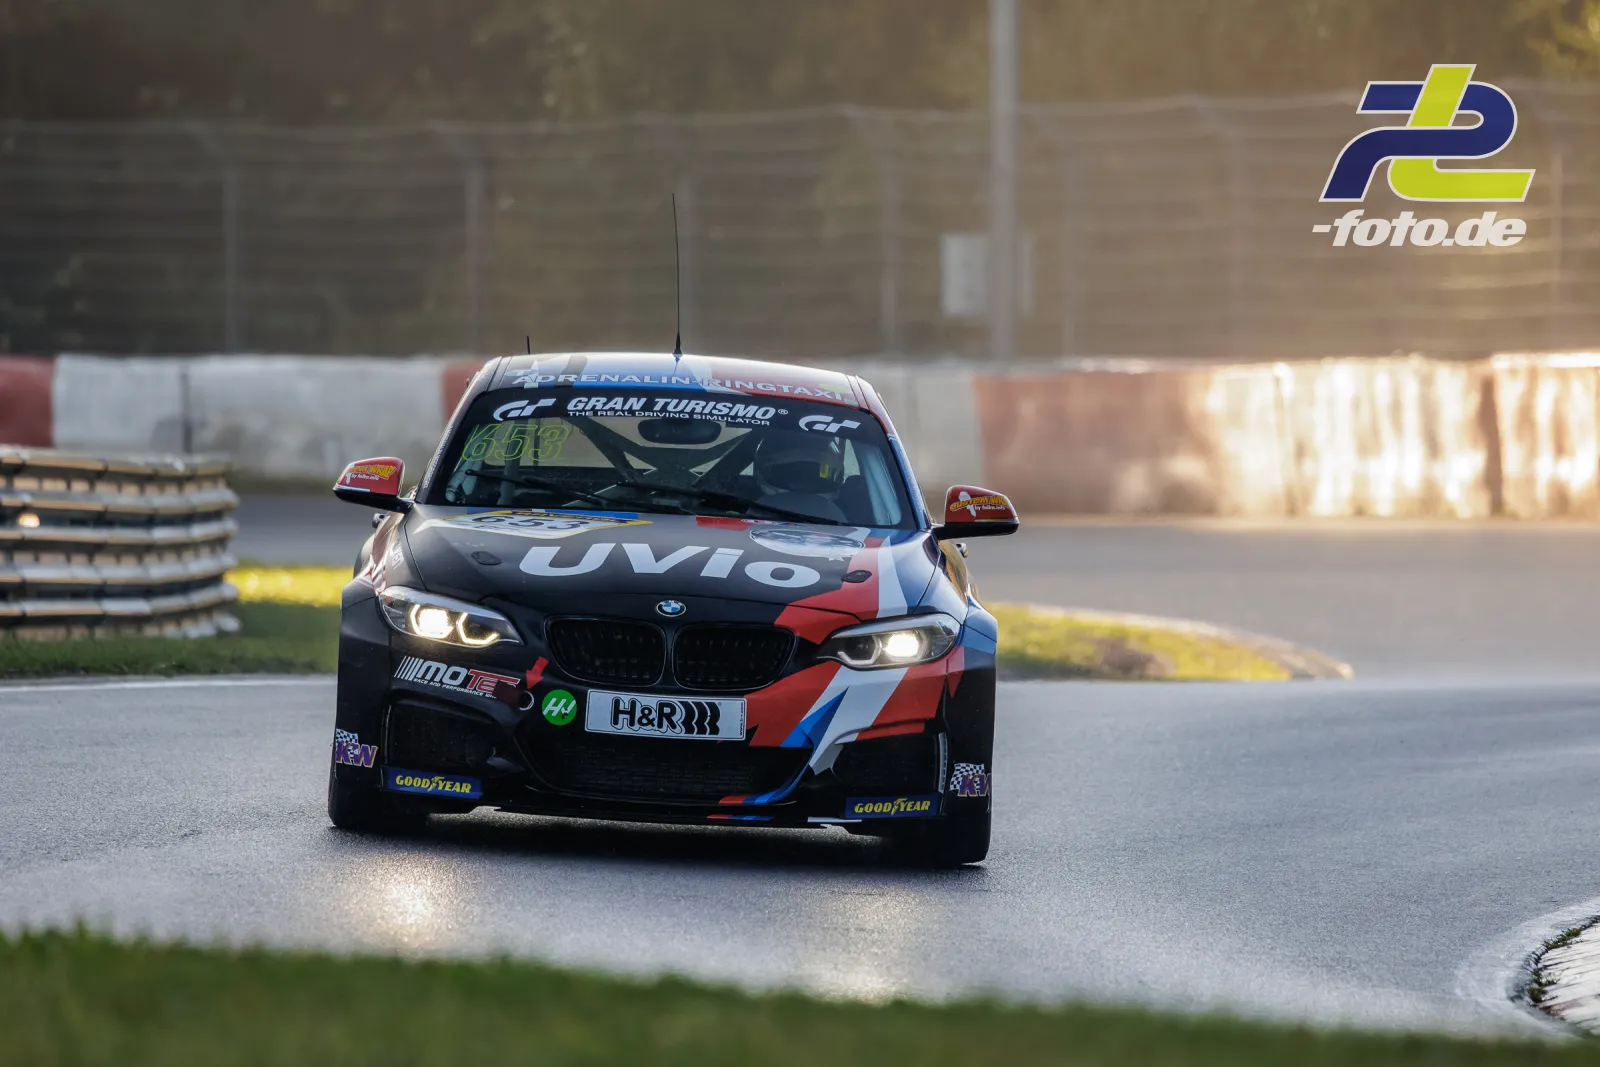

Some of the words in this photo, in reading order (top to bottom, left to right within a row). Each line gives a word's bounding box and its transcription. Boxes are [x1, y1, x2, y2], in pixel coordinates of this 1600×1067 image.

[567, 397, 647, 411] GRAN
[653, 398, 776, 420] TURISMO
[635, 411, 690, 419] DRIVING
[693, 413, 770, 426] SIMULATOR
[462, 423, 569, 462] 653
[471, 515, 590, 530] 653
[416, 660, 520, 694] MOTE
[610, 696, 683, 734] H&R
[395, 775, 472, 793] GOODYEAR
[854, 798, 931, 815] GOODYEAR
